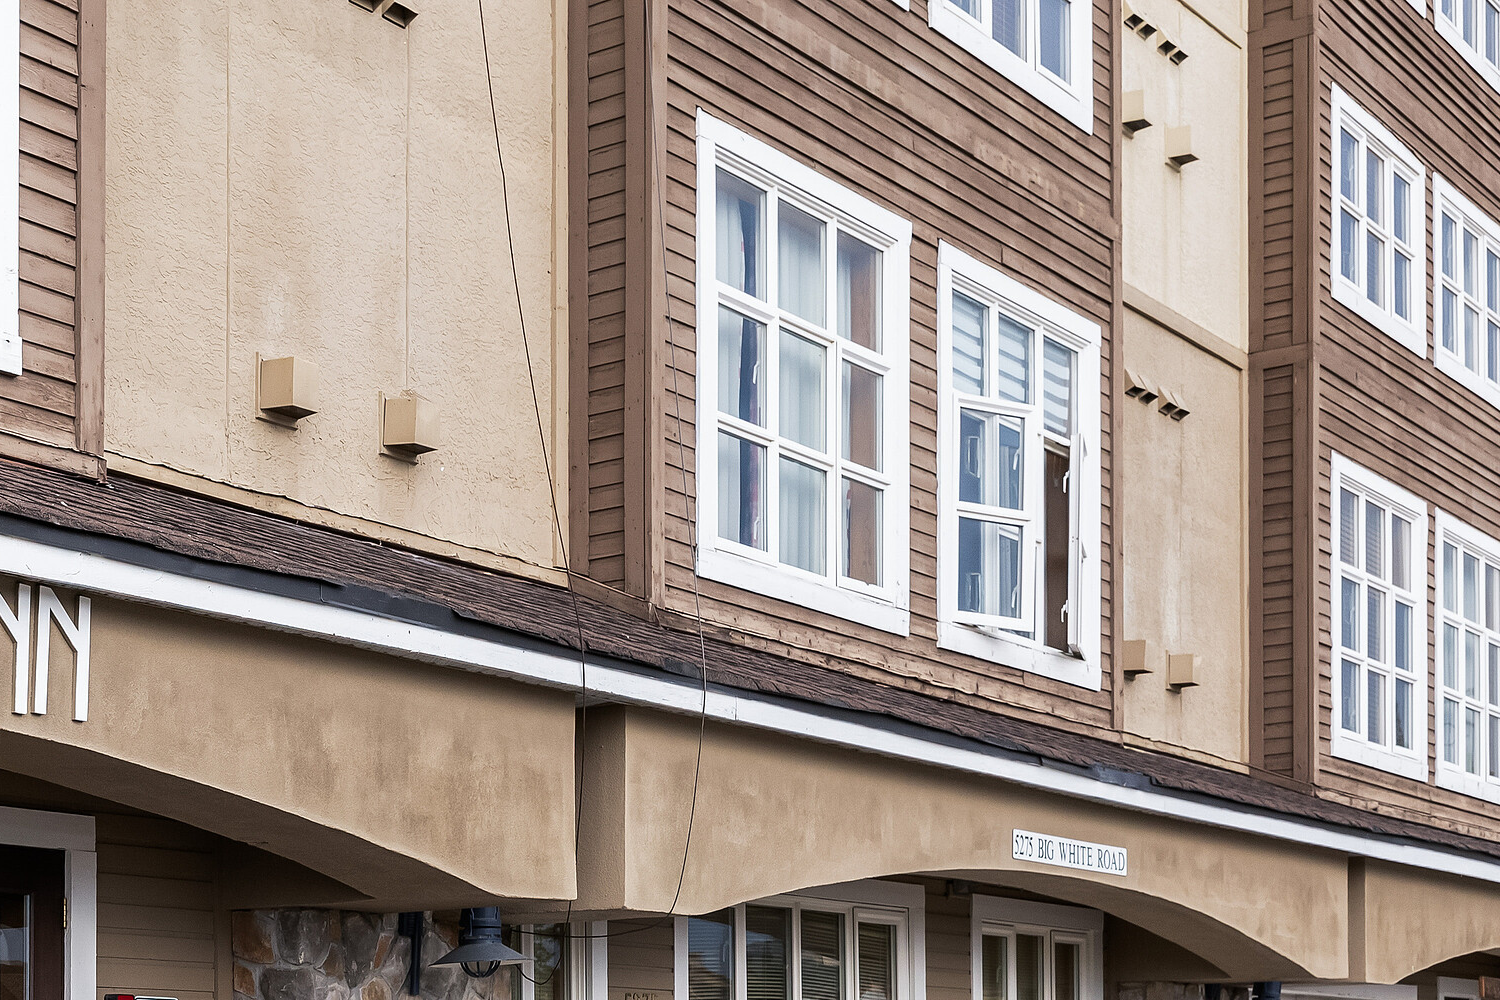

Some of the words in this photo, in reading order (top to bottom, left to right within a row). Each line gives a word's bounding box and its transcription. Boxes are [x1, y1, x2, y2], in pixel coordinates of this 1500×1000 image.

[1014, 834, 1033, 857] 5275
[1038, 838, 1054, 860] BIG
[1059, 842, 1093, 866] WHITE
[1097, 849, 1125, 871] ROAD
